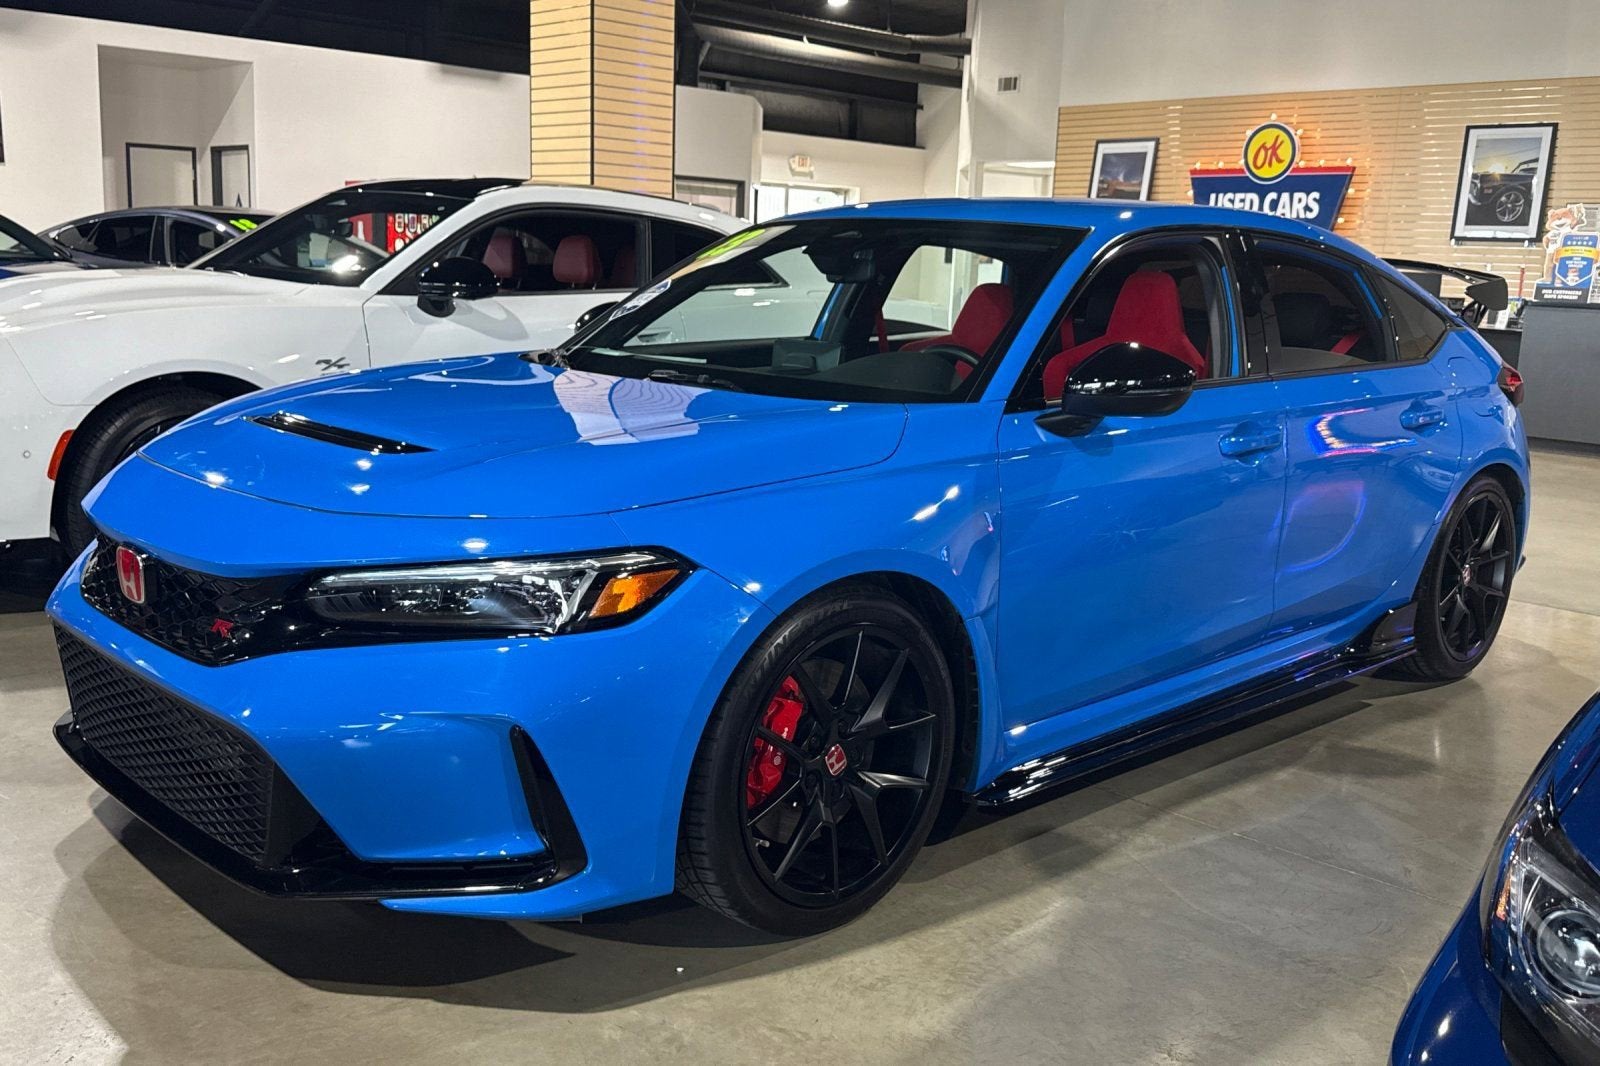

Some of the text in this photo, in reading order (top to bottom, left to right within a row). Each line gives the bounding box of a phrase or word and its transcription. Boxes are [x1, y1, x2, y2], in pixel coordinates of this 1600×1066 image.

[1253, 135, 1285, 170] OK
[1209, 192, 1320, 219] USED CARS
